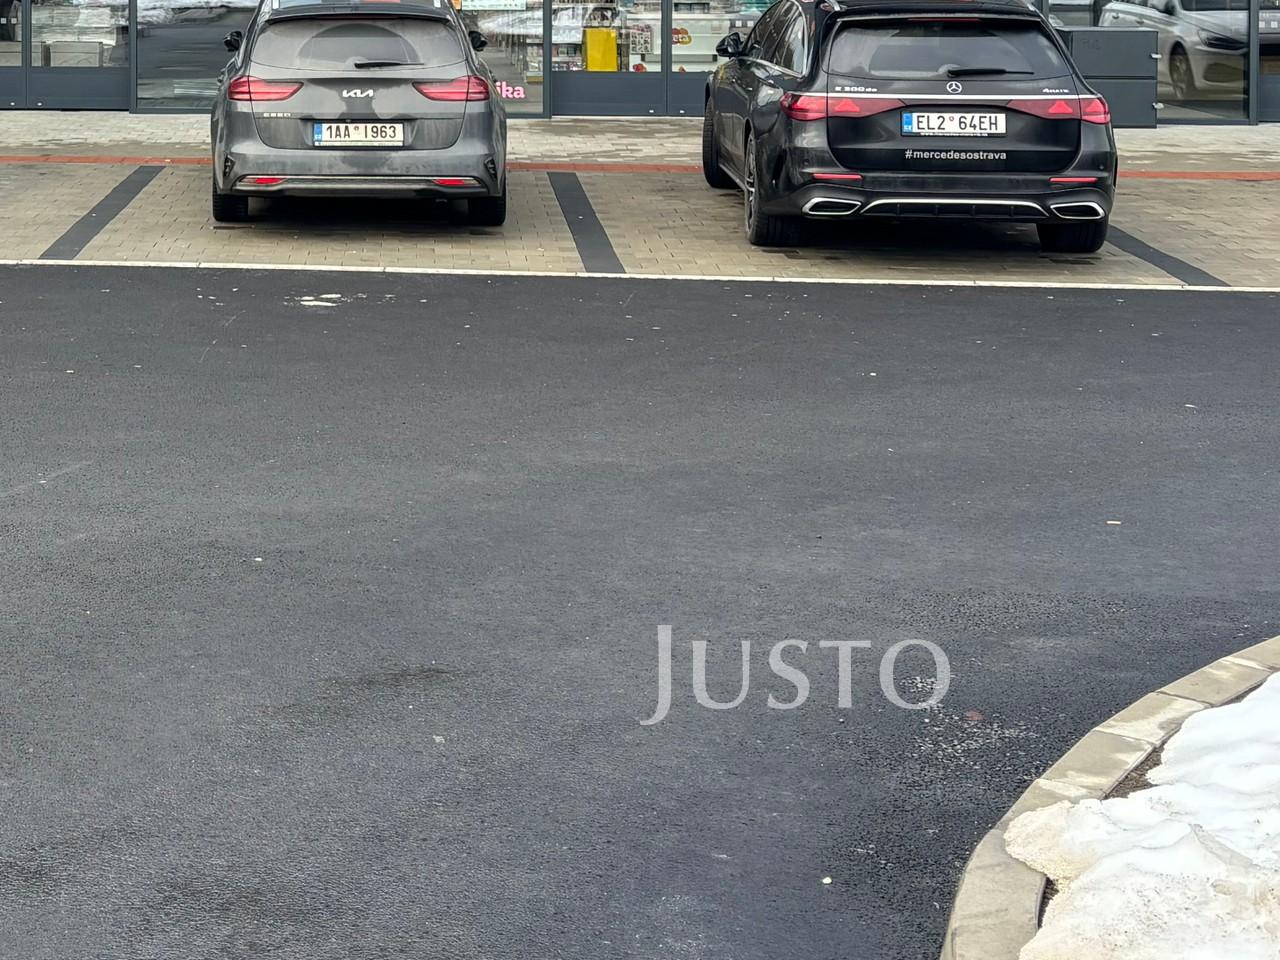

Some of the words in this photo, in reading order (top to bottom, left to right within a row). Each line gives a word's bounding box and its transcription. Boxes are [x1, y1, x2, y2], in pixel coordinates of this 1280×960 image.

[917, 115, 946, 131] EL2
[959, 115, 998, 131] 64EH
[326, 126, 351, 139] 1AA
[365, 125, 397, 139] 1963
[905, 149, 1007, 160] #mercedesostrava
